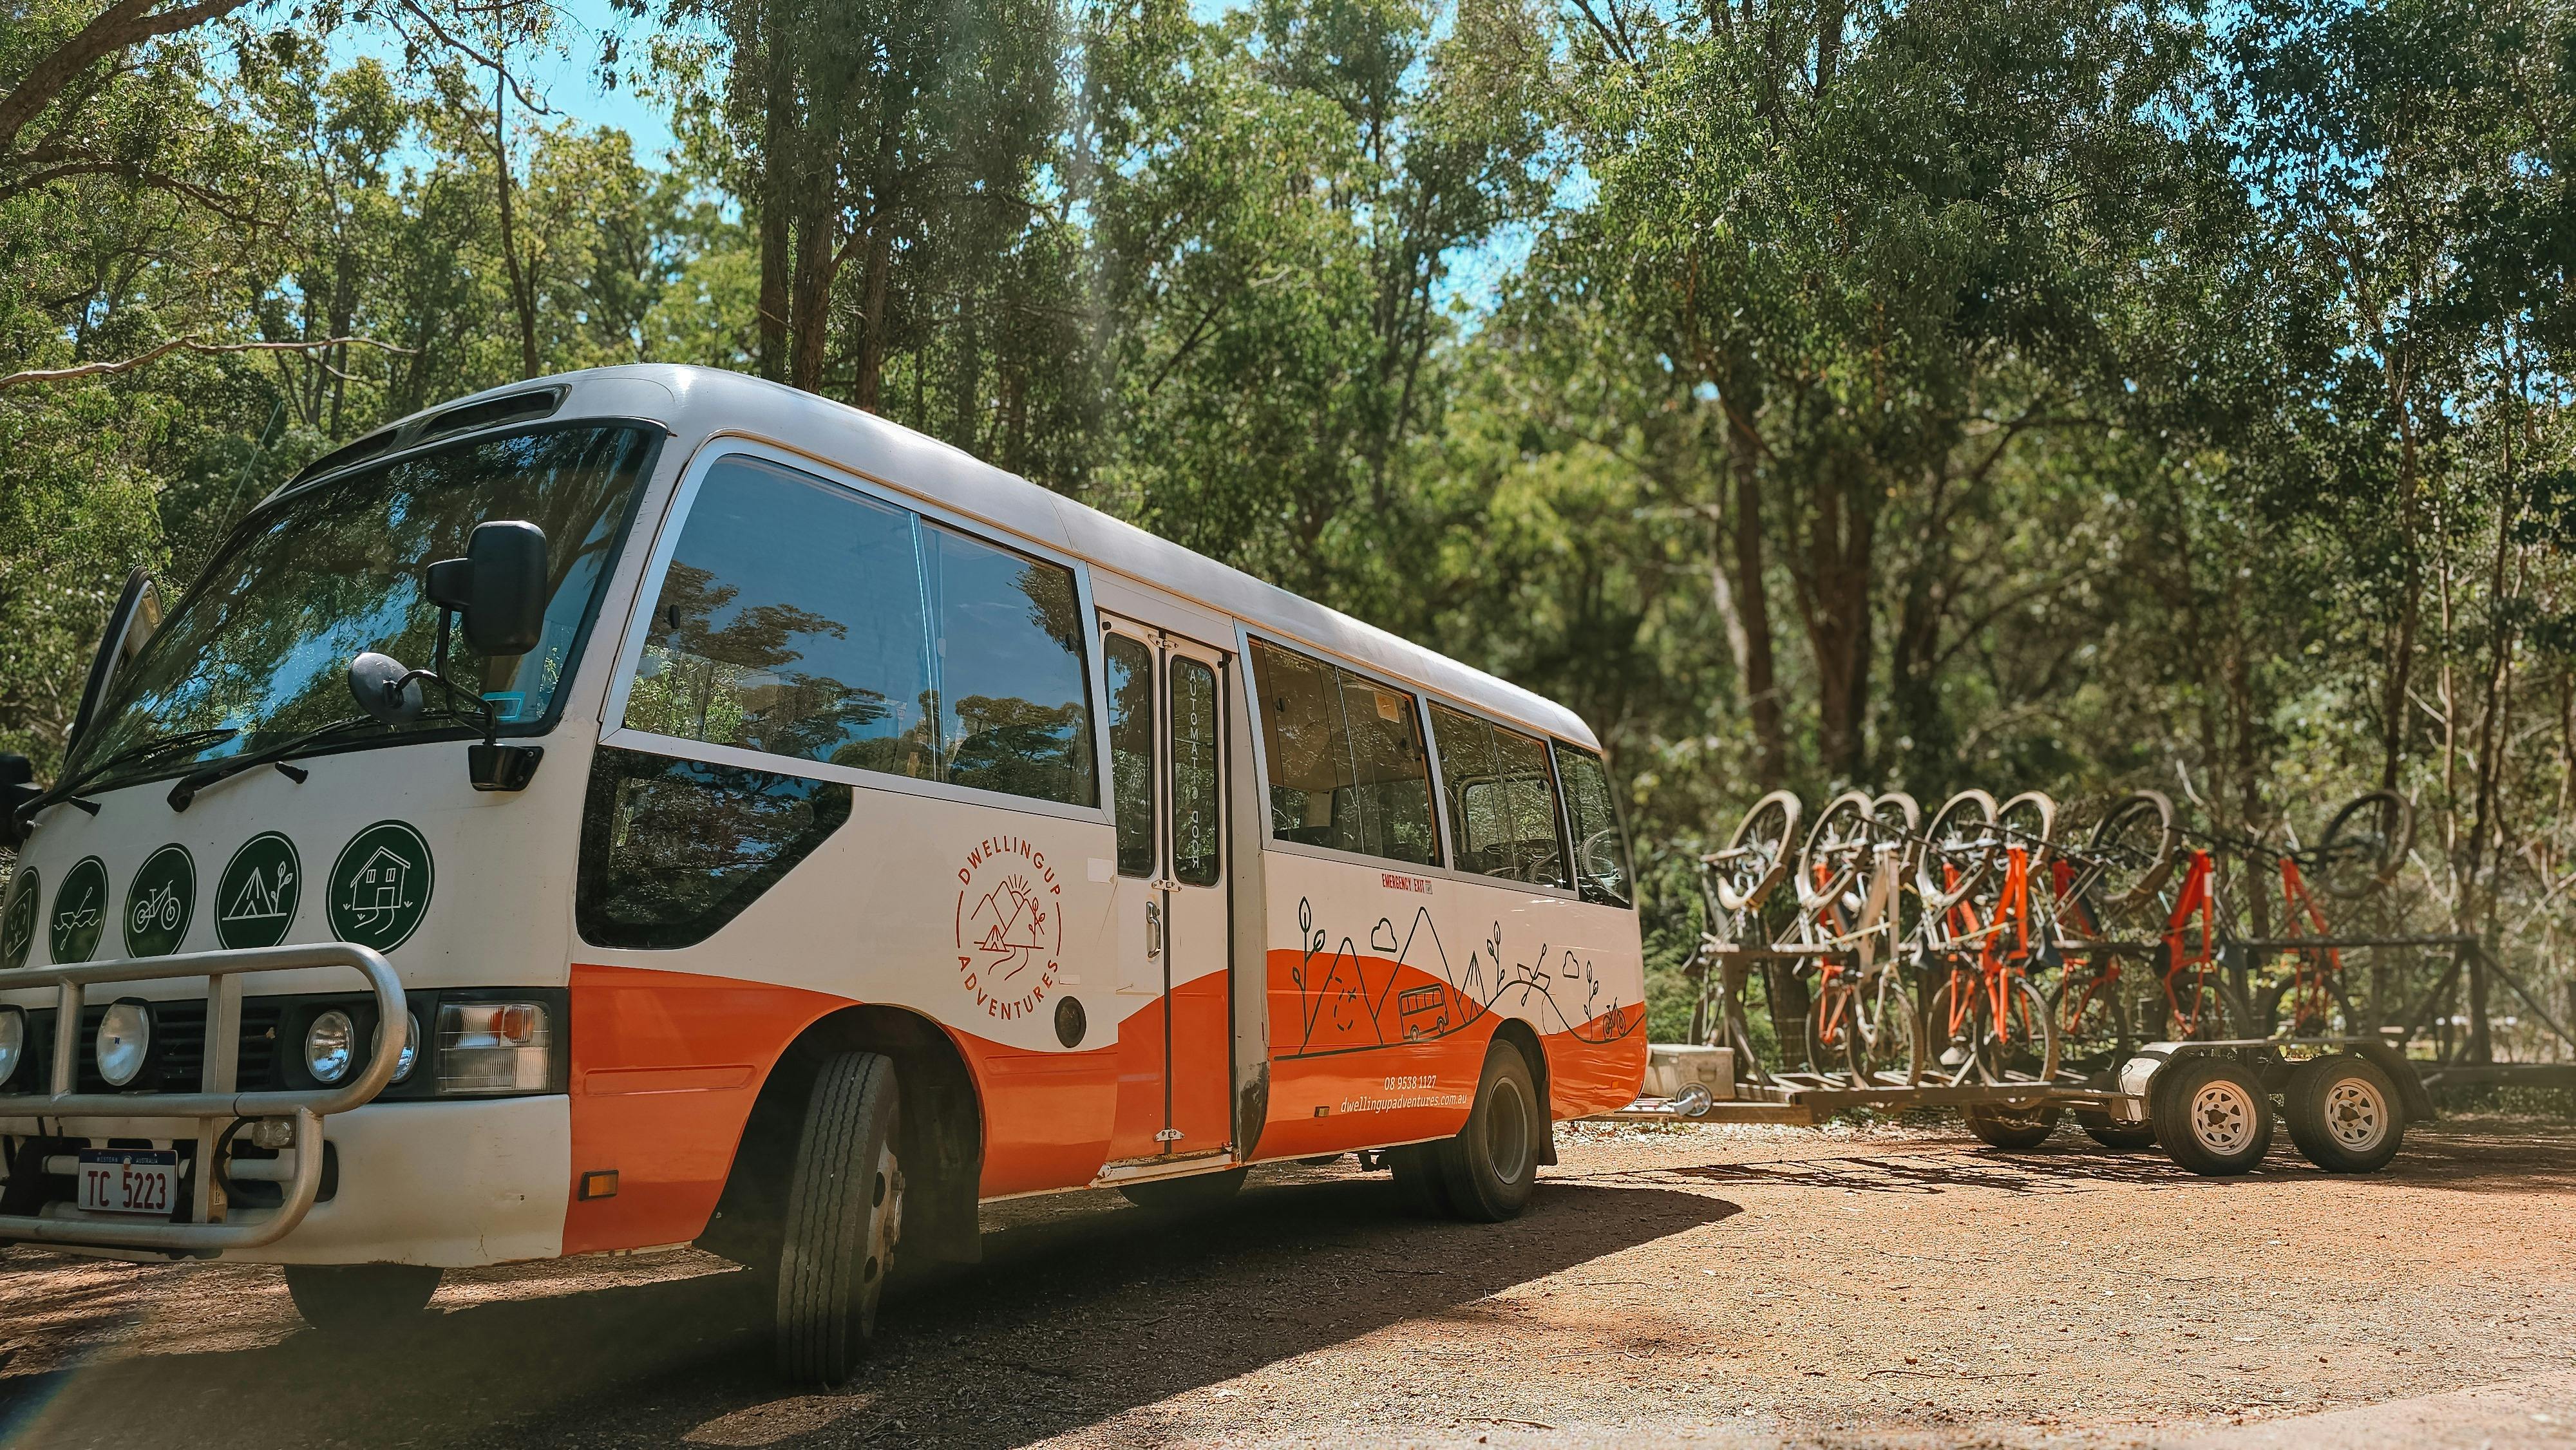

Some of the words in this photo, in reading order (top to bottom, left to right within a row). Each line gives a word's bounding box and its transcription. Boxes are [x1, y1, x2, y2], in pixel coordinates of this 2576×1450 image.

[958, 836, 1061, 896] DWELLINGUP
[1381, 874, 1412, 892] EMERGENCY
[1414, 878, 1425, 893] EXIT
[958, 956, 1058, 1020] ADVENTURES
[1384, 1077, 1394, 1090] 08
[1397, 1076, 1416, 1089] 9538
[1419, 1075, 1437, 1089] 1127
[1341, 1094, 1467, 1113] dwellingupadventures.com.au
[88, 1171, 110, 1207] TC
[123, 1172, 166, 1209] 5223
